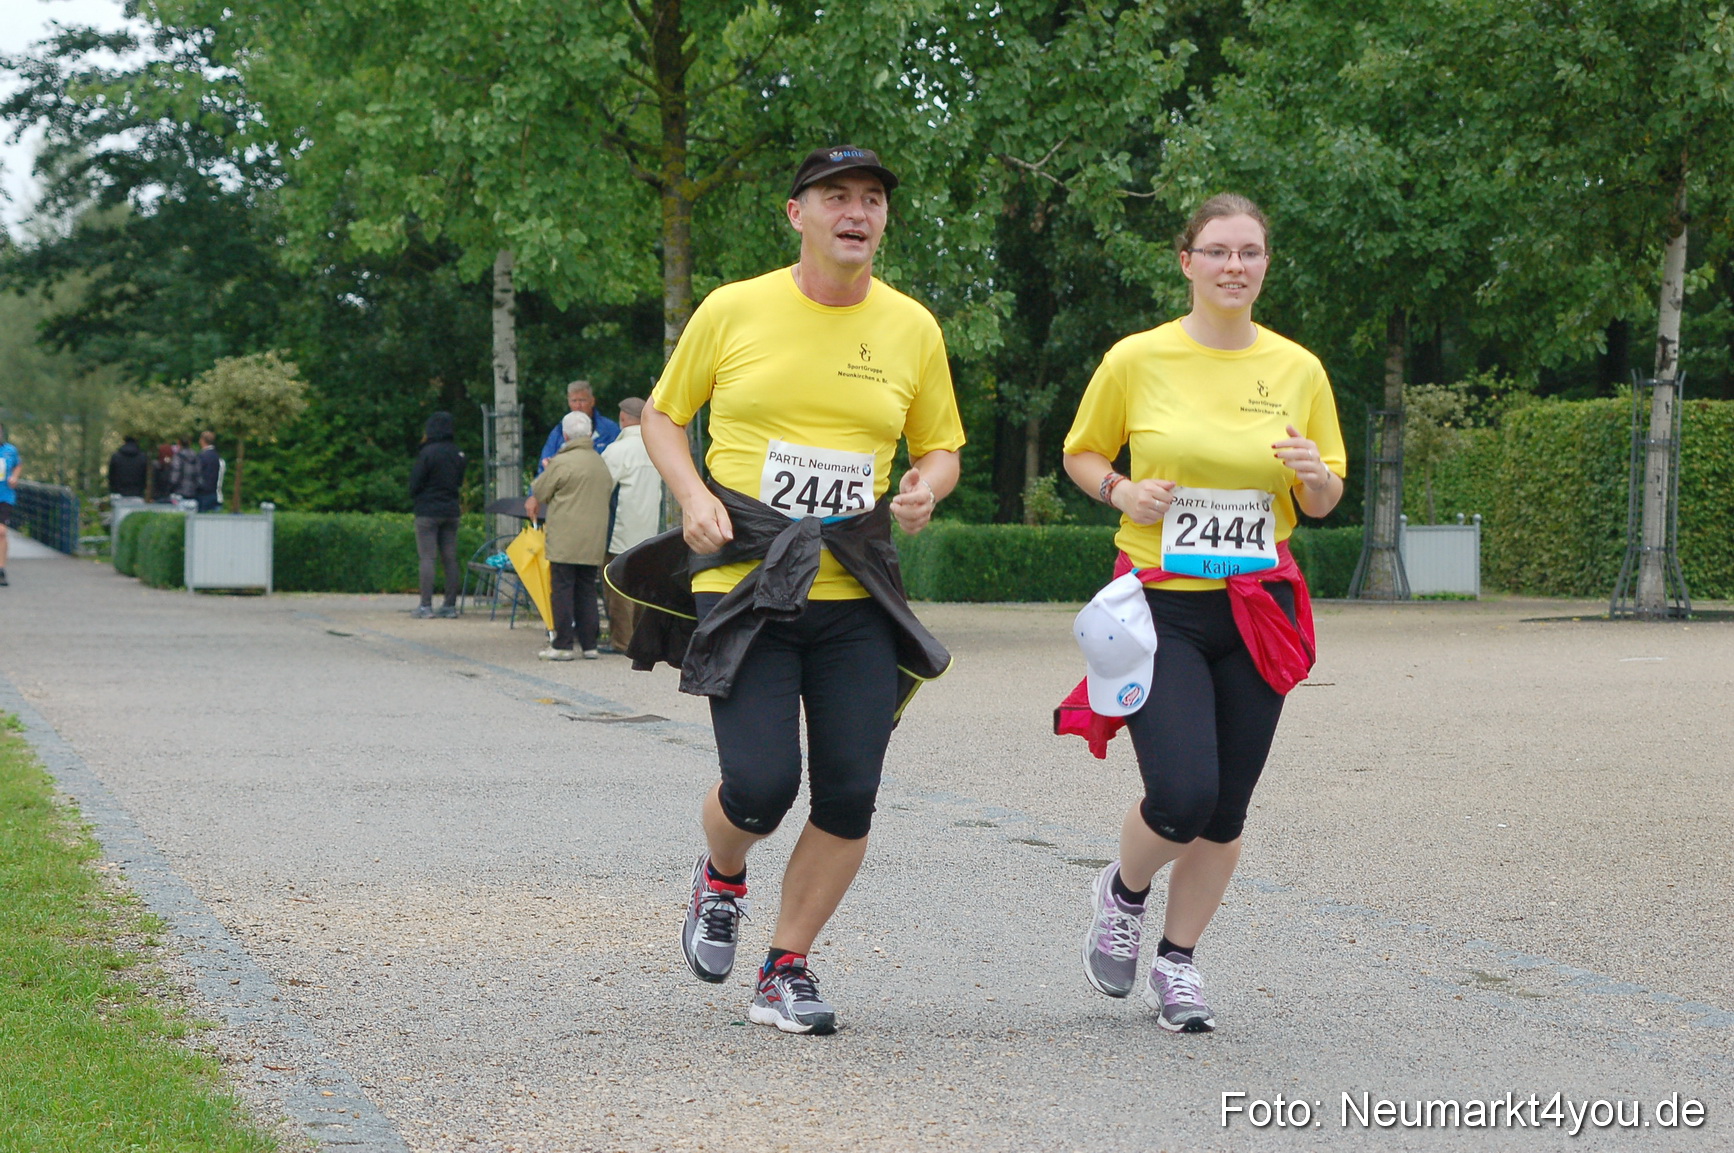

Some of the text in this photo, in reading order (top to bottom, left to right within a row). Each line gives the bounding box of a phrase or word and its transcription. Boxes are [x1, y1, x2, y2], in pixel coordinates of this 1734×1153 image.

[837, 371, 875, 381] Neunkirchen
[769, 451, 860, 474] PARTL Neumarkt
[771, 470, 865, 515] 2445
[1170, 496, 1207, 508] PARTL
[1175, 512, 1266, 551] 2444
[1203, 560, 1240, 577] Katja
